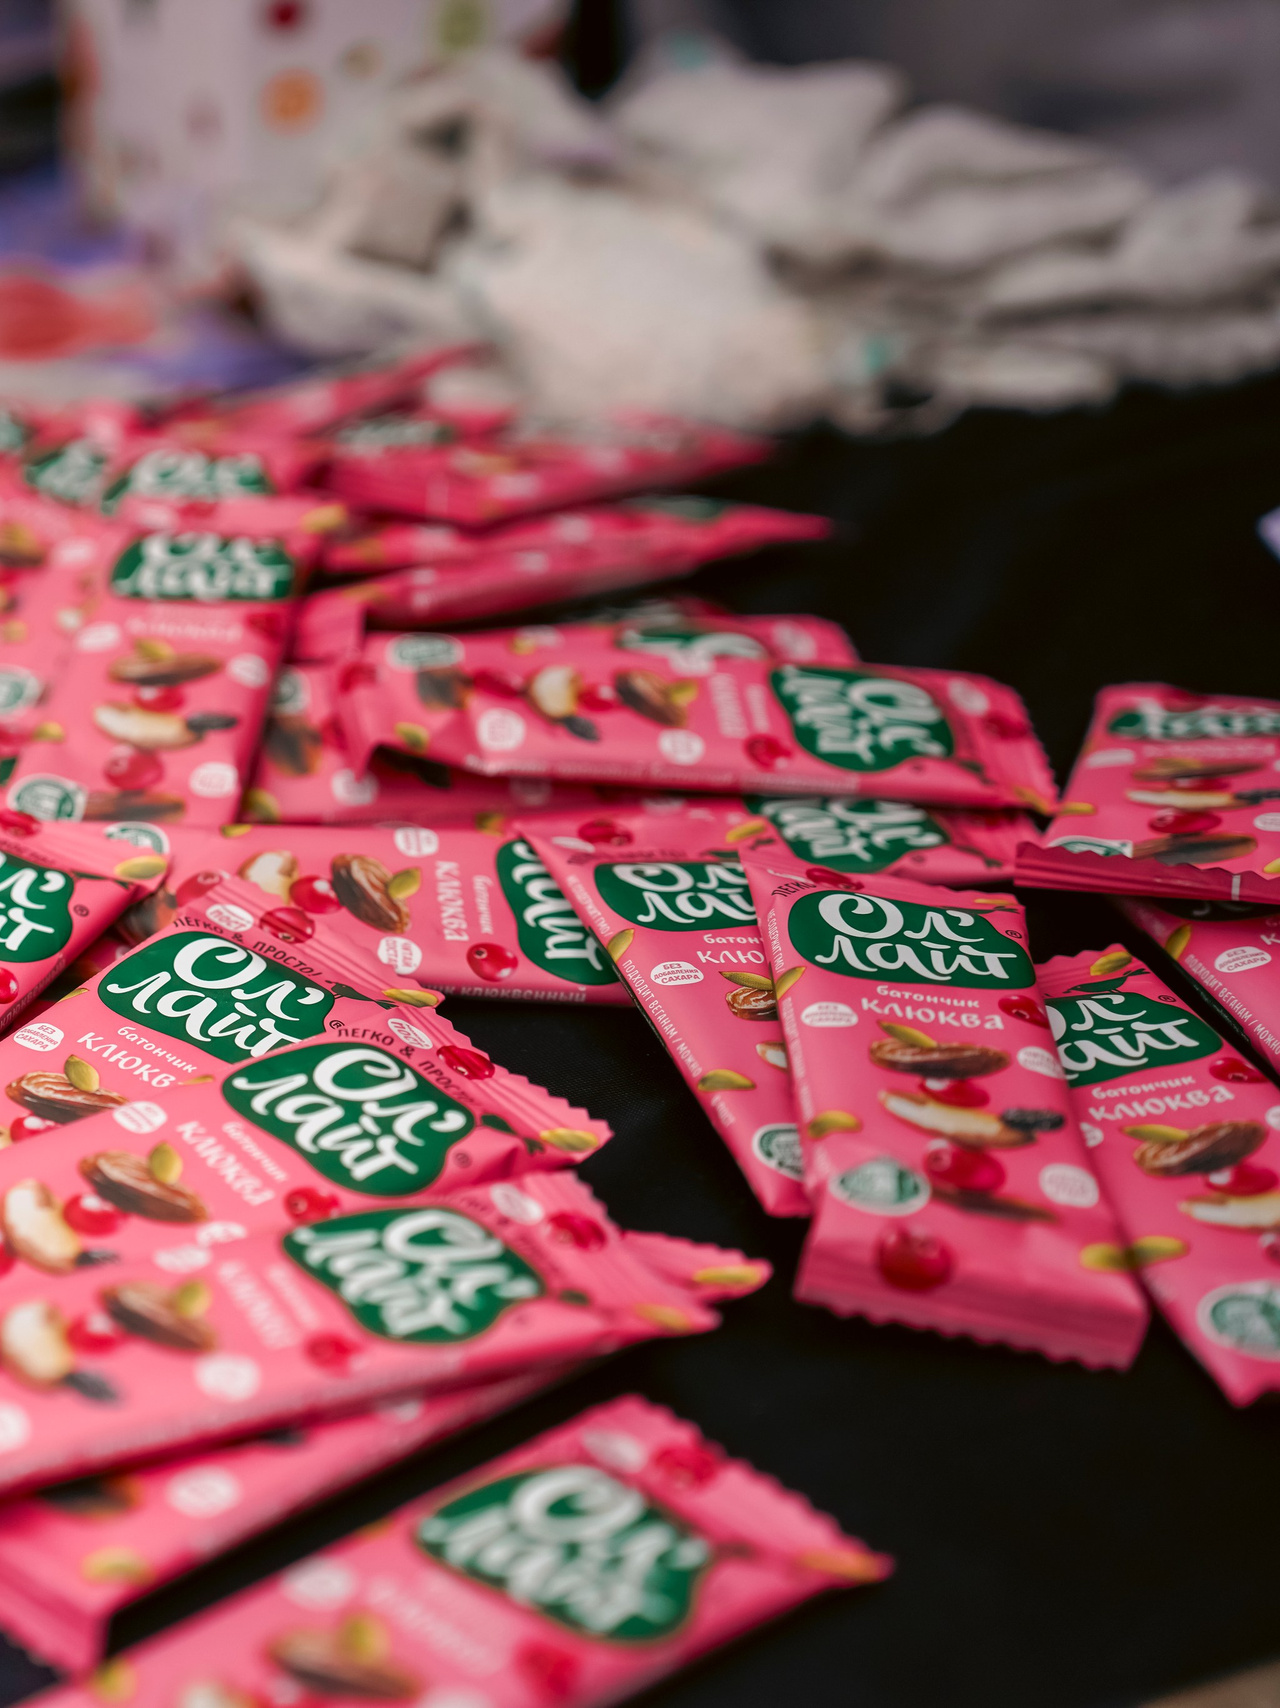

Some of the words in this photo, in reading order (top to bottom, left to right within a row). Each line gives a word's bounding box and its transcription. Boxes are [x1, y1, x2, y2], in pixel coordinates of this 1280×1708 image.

[636, 887, 757, 924] лай
[818, 893, 984, 942] Ол'
[173, 916, 224, 935] ЛЕГКО
[252, 940, 324, 978] ПРОСТО!
[696, 950, 766, 965] клю
[703, 933, 762, 945] батон
[815, 934, 1017, 981] лайт
[173, 937, 326, 1022] Ол'
[661, 974, 701, 984] САХАРА
[1226, 956, 1268, 972] САХАРА
[876, 985, 980, 1009] батончик
[1184, 954, 1223, 992] ПОДХОДИТ
[1219, 988, 1253, 1023] ВЕГАНАМ
[37, 1024, 56, 1035] БЕЗ
[106, 971, 304, 1057] лайт
[336, 1028, 395, 1047] ЛЕГКО
[622, 959, 655, 1002] ПОДХОДИТ
[648, 999, 678, 1040] ВЕГАНАМ
[676, 1042, 703, 1078] МОЖНО
[15, 1033, 49, 1050] САХАРА
[76, 1031, 182, 1089] клюкв
[117, 1025, 198, 1074] батончик
[1058, 1018, 1200, 1080] айт
[313, 1048, 466, 1147] Ол'
[1092, 1075, 1197, 1100] батончик
[232, 1073, 419, 1181] лайт
